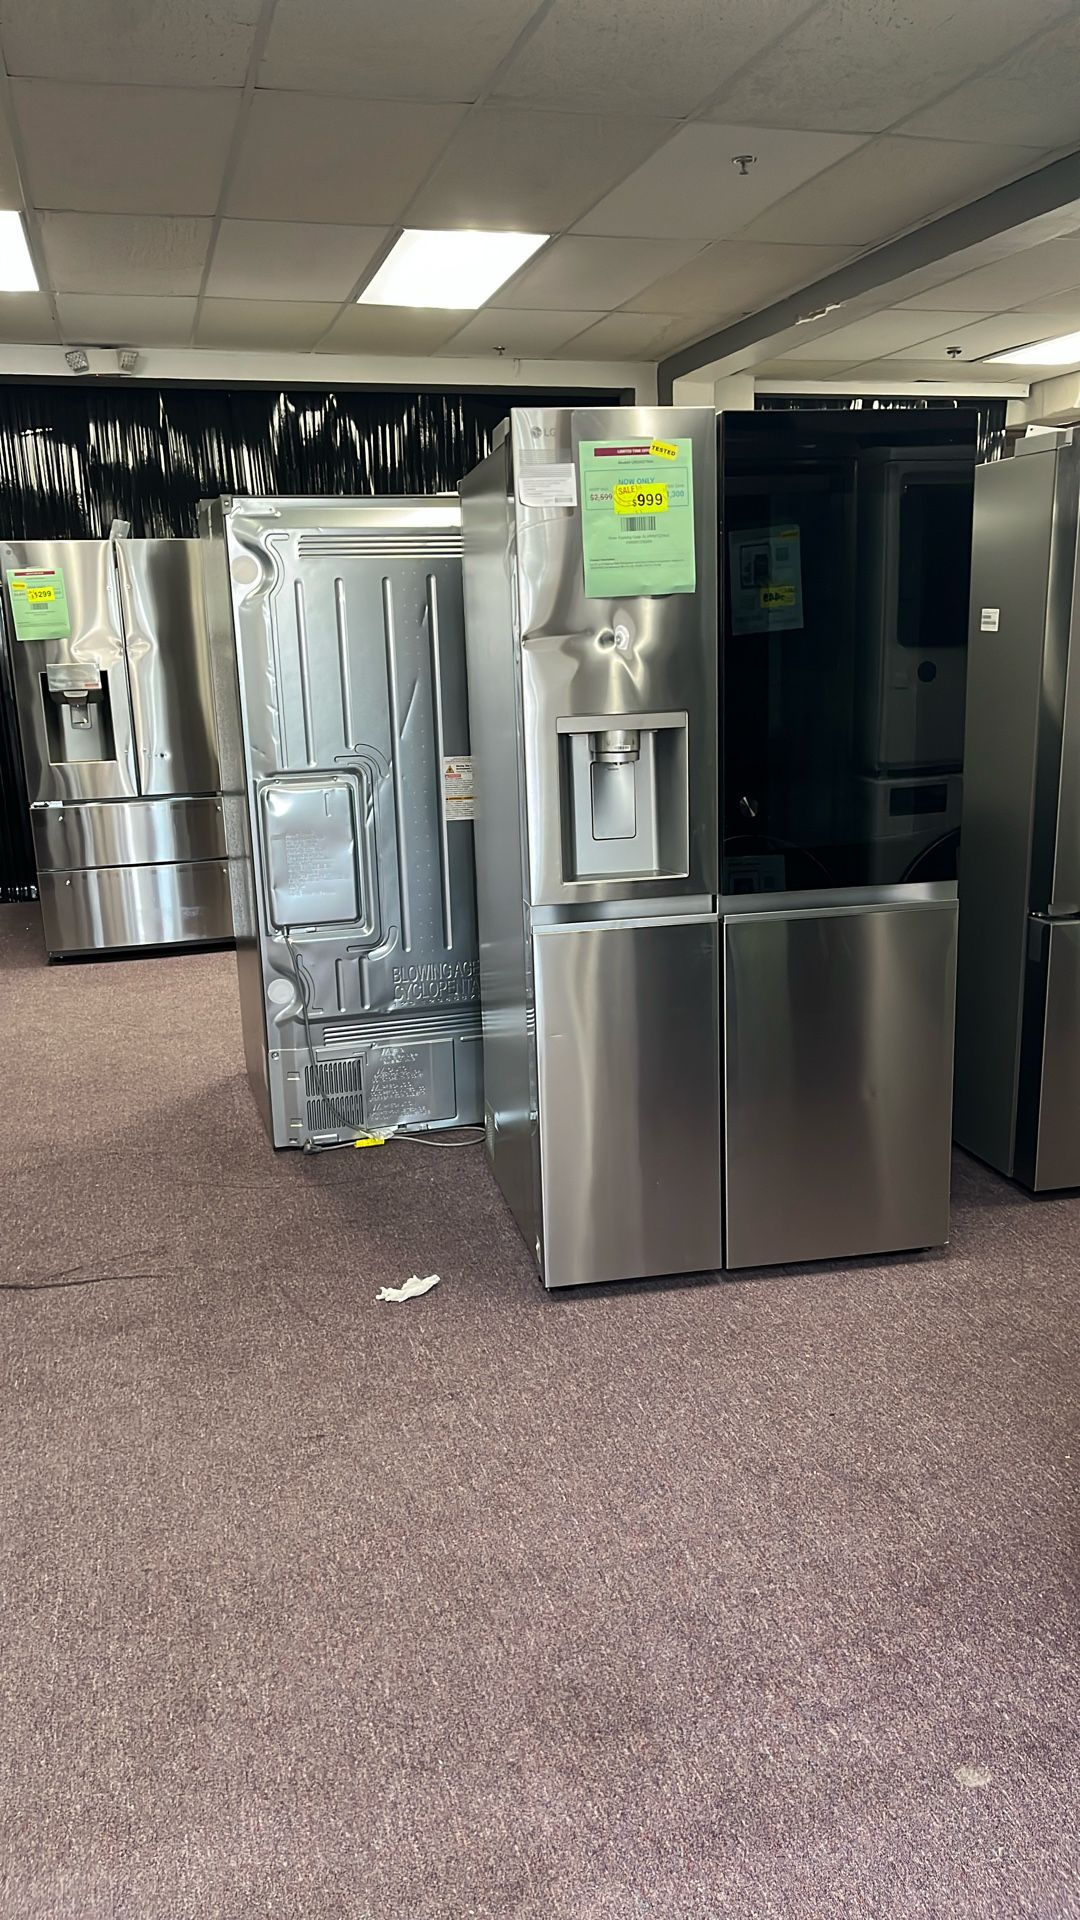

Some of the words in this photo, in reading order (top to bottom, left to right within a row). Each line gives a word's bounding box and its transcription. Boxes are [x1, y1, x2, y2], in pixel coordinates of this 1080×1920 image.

[544, 428, 556, 437] LG
[652, 445, 676, 457] TESTED
[617, 486, 635, 495] SALE
[632, 493, 663, 507] $999
[393, 963, 452, 984] BLOWING
